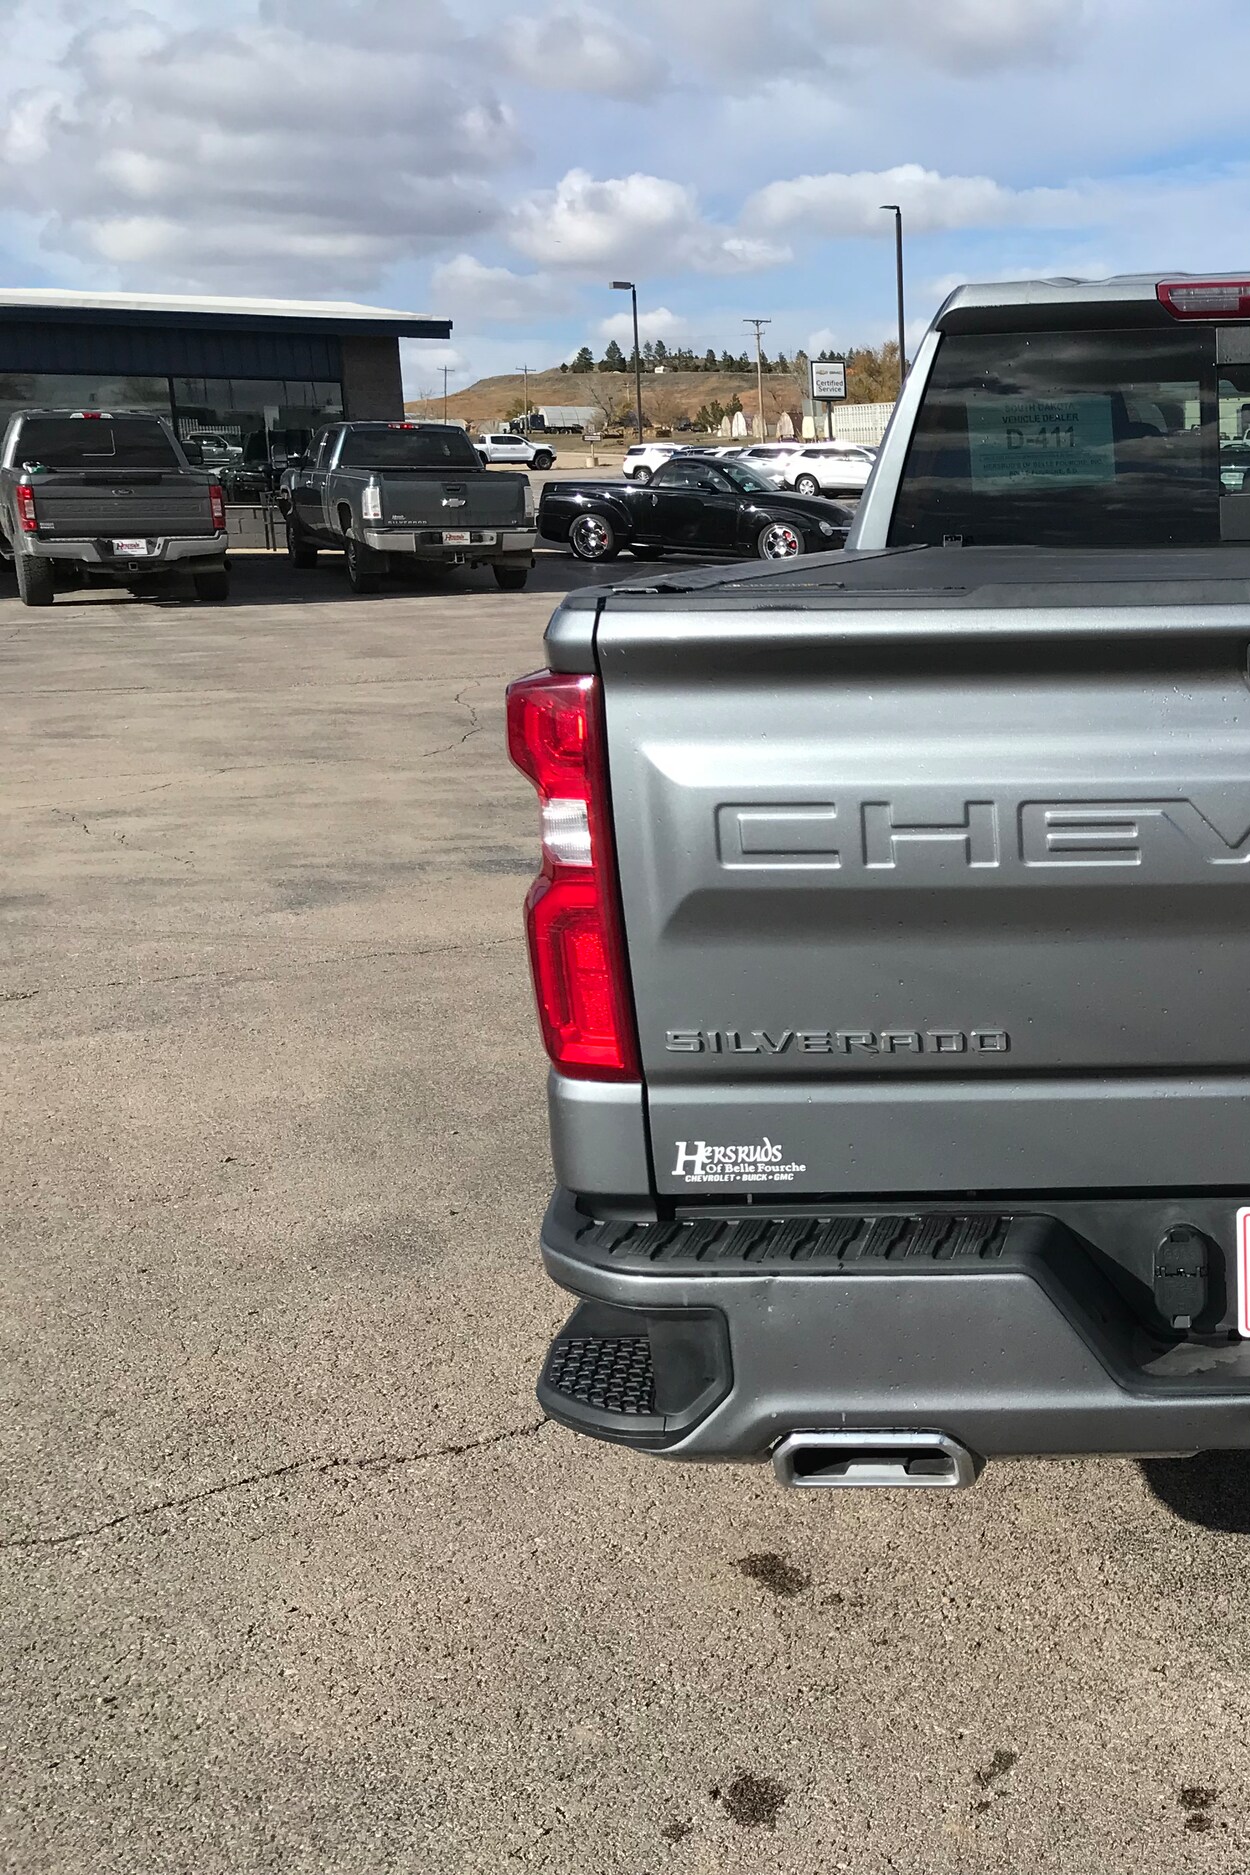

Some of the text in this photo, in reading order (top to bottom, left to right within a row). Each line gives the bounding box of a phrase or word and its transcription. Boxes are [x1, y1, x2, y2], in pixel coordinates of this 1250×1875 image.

[1004, 402, 1075, 413] SOUTH DAKOTA
[1002, 412, 1079, 424] VEHICLE DEALER
[1006, 426, 1075, 450] D-411
[665, 1030, 1012, 1054] SILVERADO
[706, 1162, 806, 1173] Of Belle Fourche
[685, 1172, 795, 1182] CHEVROLET BUICK GMC
